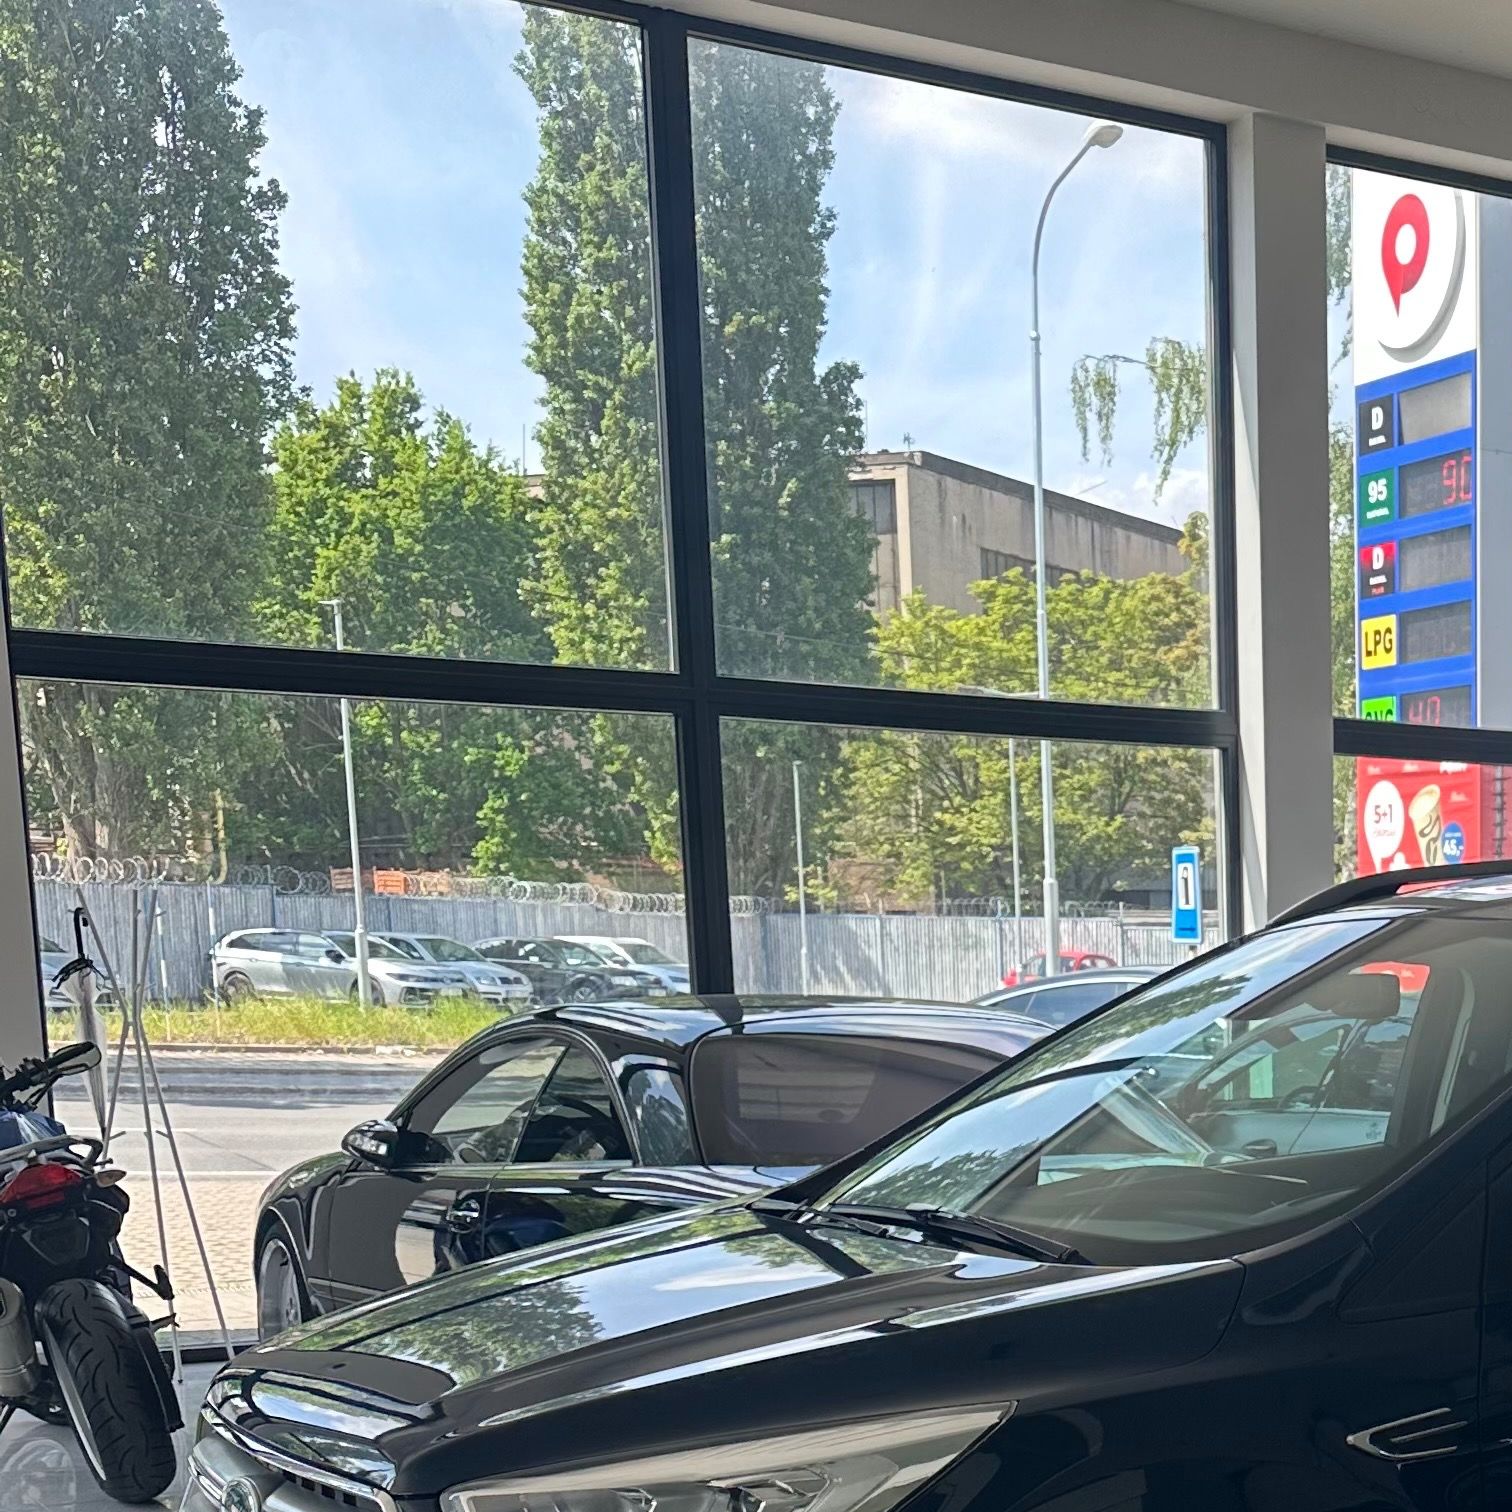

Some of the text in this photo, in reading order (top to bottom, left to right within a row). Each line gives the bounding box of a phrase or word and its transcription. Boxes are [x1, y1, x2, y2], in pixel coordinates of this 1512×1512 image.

[1371, 406, 1384, 431] D
[1367, 477, 1388, 504] 95
[1372, 546, 1385, 570] D
[1364, 626, 1393, 657] LPG
[1374, 803, 1393, 824] 5+1
